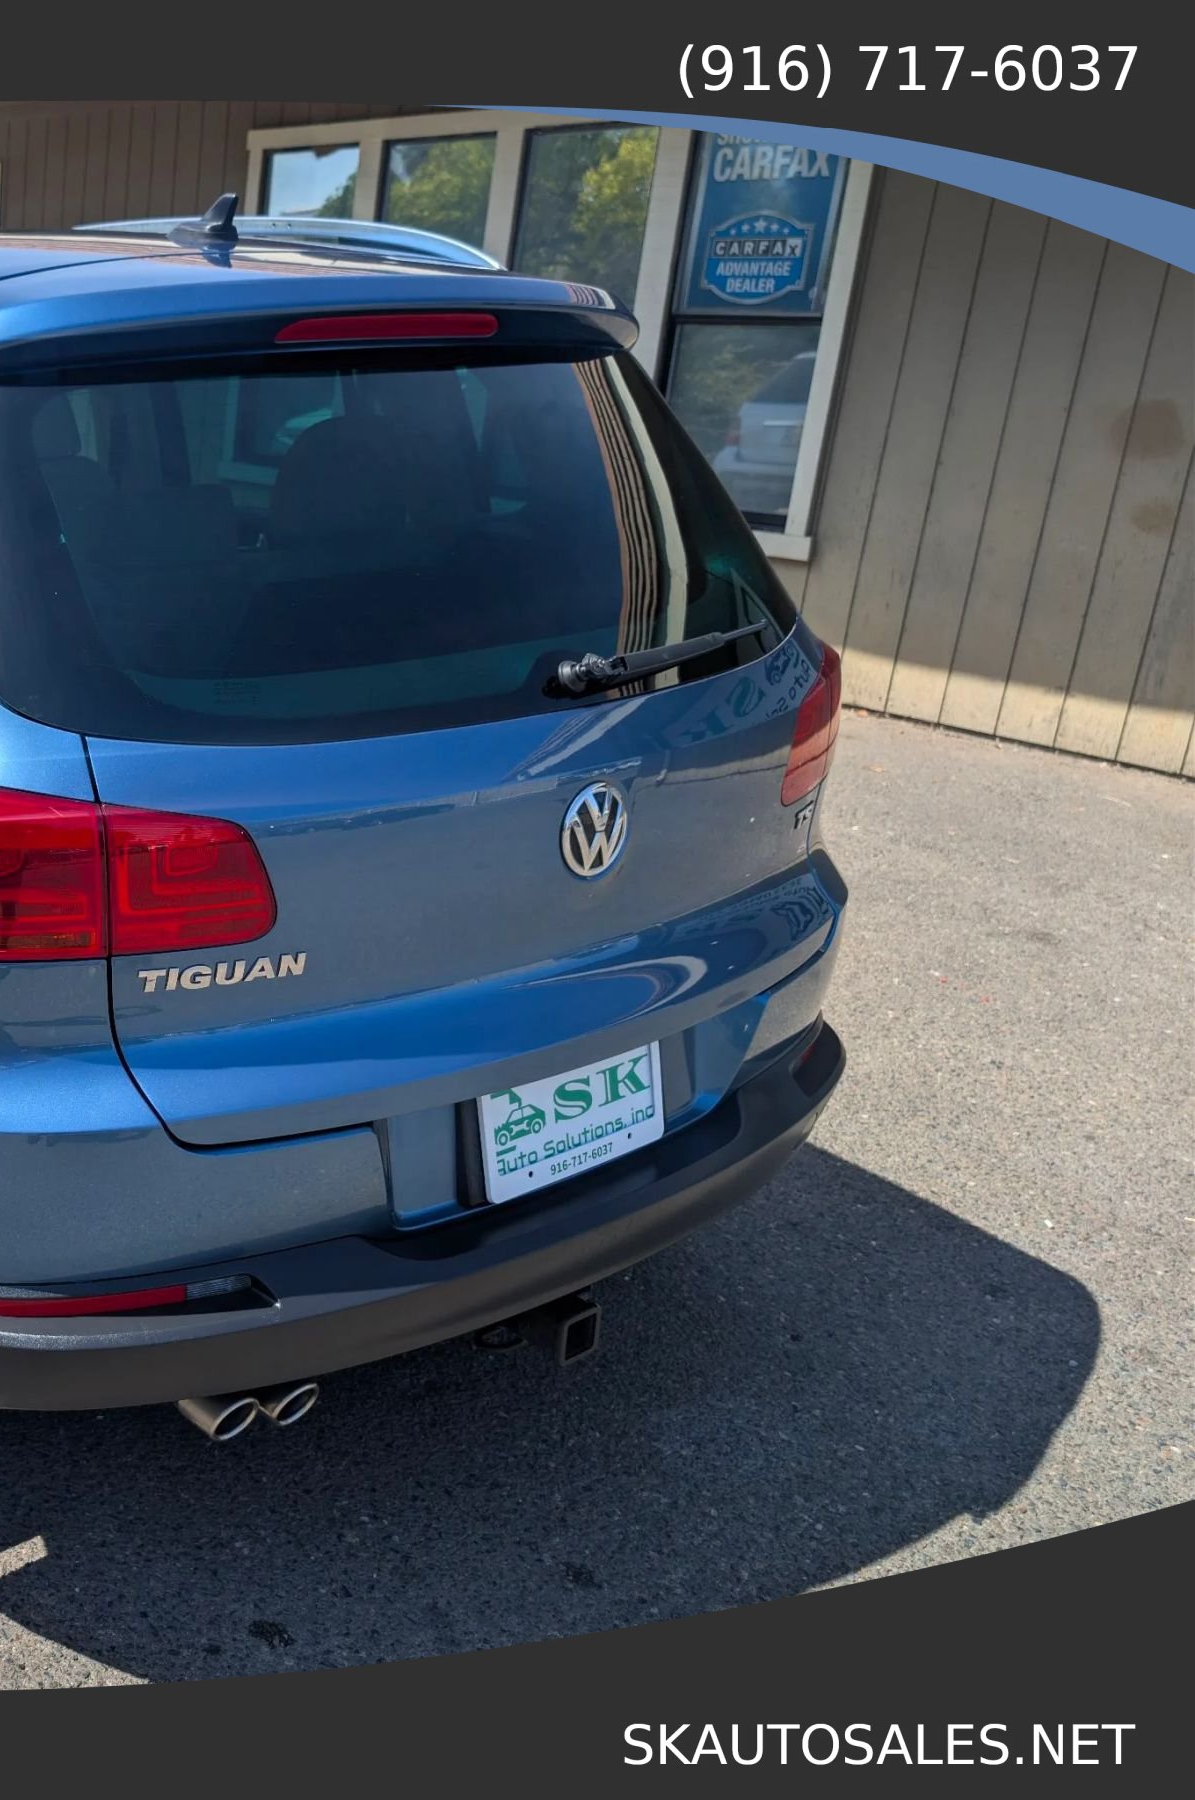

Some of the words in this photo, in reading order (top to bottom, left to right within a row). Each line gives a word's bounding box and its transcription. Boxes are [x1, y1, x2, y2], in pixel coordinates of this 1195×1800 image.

[713, 145, 830, 182] CARFAX
[715, 240, 800, 257] CARFAX
[715, 261, 792, 277] ADVANTAGE
[725, 278, 776, 294] DEALER
[137, 951, 308, 993] TIGUAN
[553, 1053, 651, 1124] SK
[550, 1142, 614, 1176] 916-717-6037
